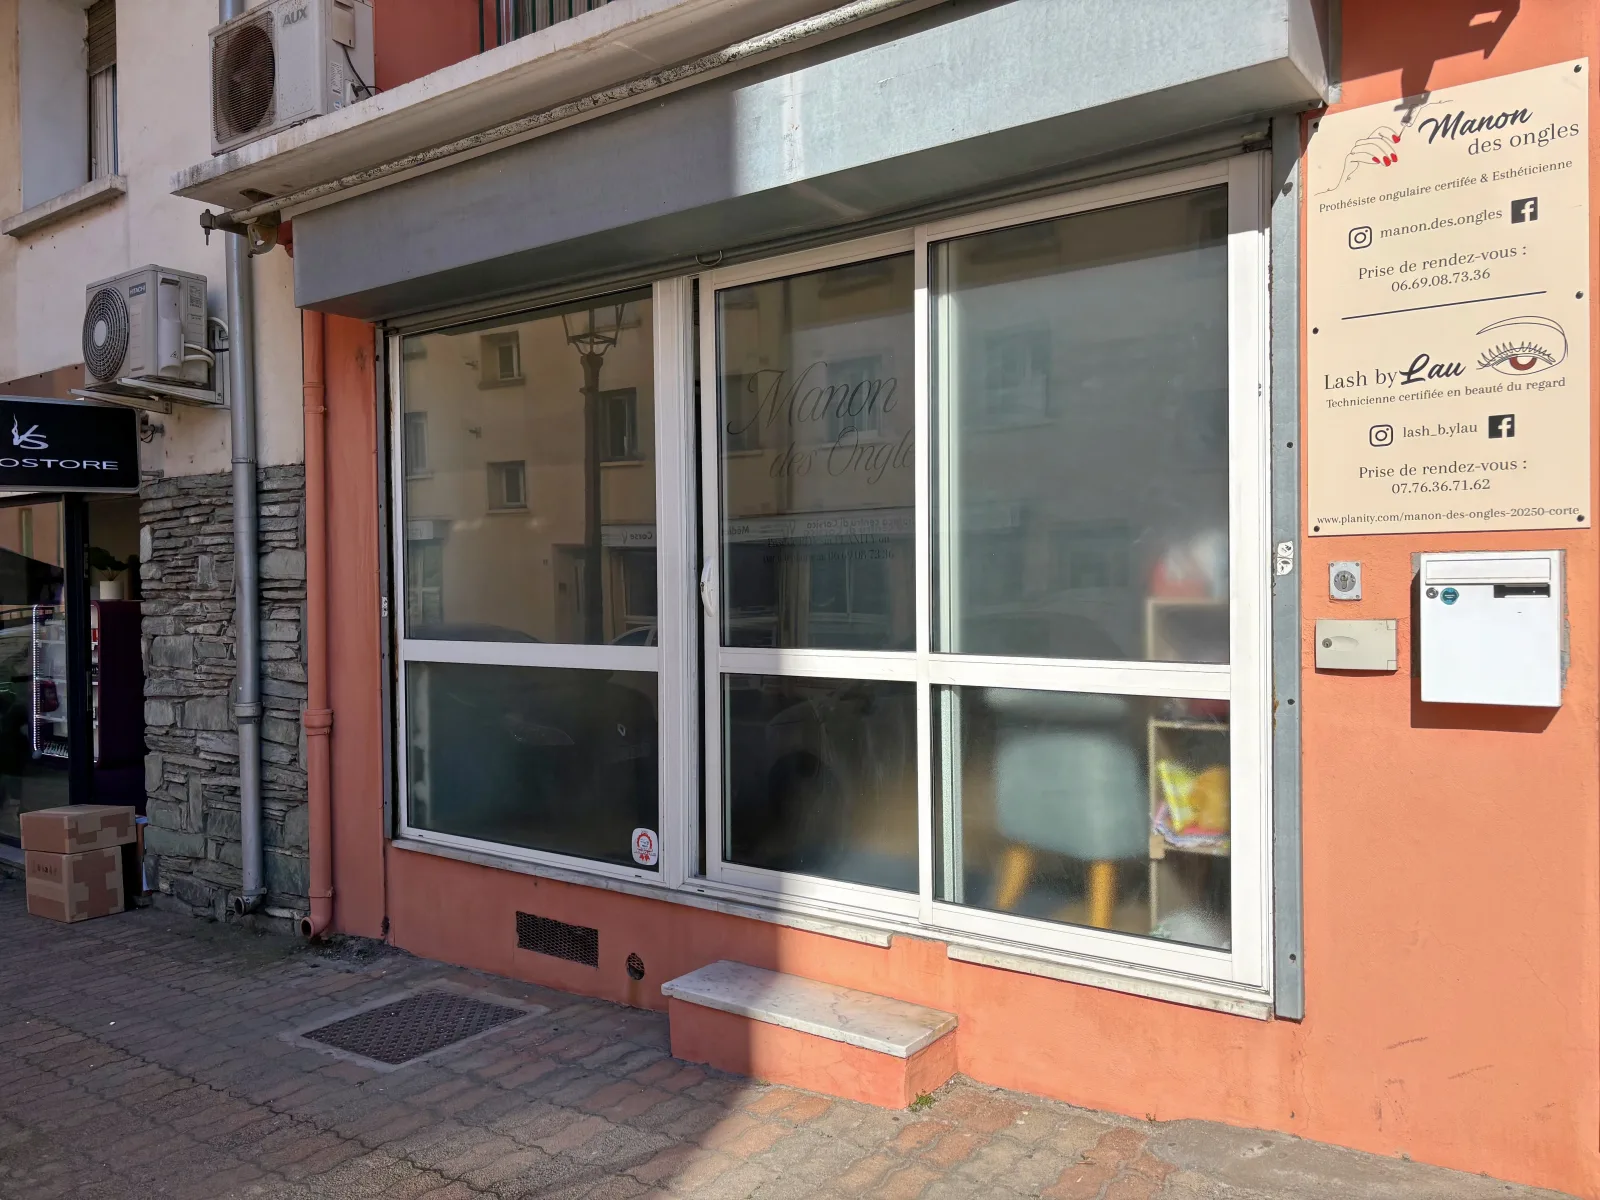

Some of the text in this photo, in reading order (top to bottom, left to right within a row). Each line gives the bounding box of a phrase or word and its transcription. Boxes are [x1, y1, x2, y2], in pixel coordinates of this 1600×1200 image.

[283, 6, 308, 27] AUX
[1418, 107, 1533, 145] Manon
[1467, 122, 1580, 156] des ongles
[1319, 193, 1376, 213] Prothésiste
[1379, 184, 1432, 202] ongulaire
[1480, 173, 1489, 184] &
[1492, 159, 1573, 181] Esthéticienne
[1380, 208, 1503, 239] manon.des.ongles
[1358, 264, 1395, 281] Prise
[1399, 261, 1418, 274] de
[1422, 245, 1518, 271] rendez-vous
[1391, 268, 1491, 293] 06.69.08.73.36
[1324, 353, 1467, 390] Lash by Lau
[727, 361, 898, 435] Manon
[1326, 393, 1396, 409] Technicienne
[1447, 388, 1461, 397] en
[1464, 382, 1503, 396] beauté
[1506, 381, 1522, 392] du
[1526, 377, 1566, 392] regard
[1403, 421, 1478, 439] lash_b.ylau
[768, 441, 818, 479] des
[1358, 466, 1395, 479] Prise
[1399, 464, 1418, 477] de
[1422, 458, 1518, 476] rendez-vous
[1391, 478, 1491, 494] 07.76.36.71.62
[1317, 506, 1580, 525] www.planity.com/manon-des-ongles-20250-corte
